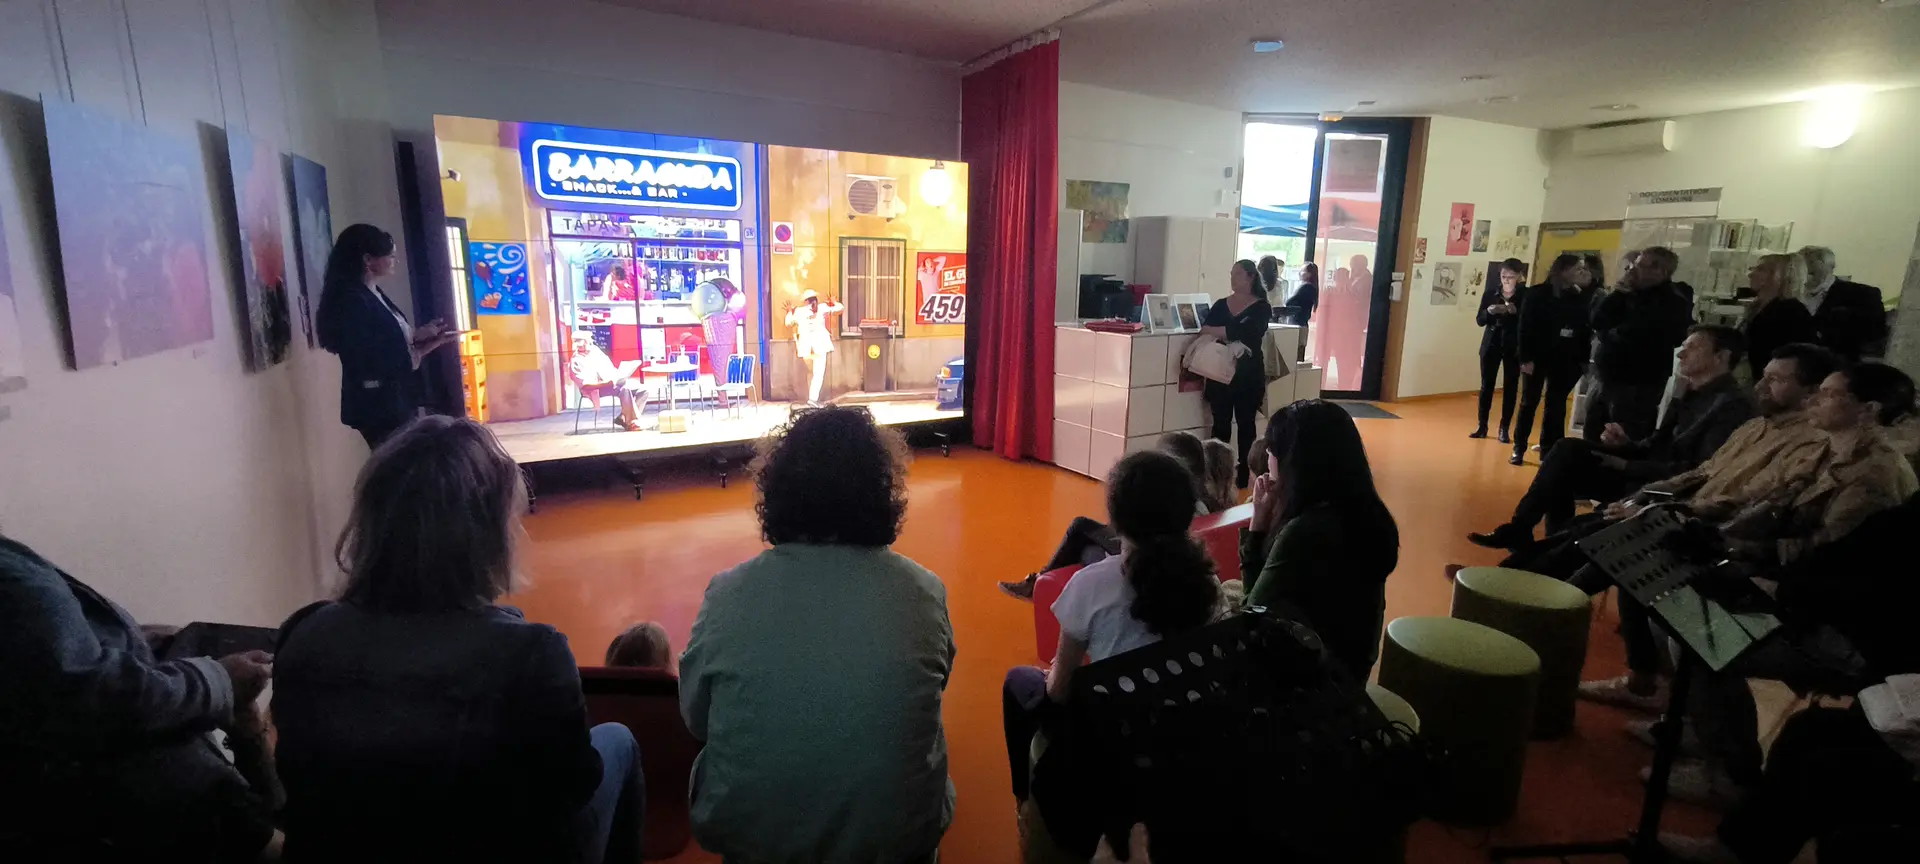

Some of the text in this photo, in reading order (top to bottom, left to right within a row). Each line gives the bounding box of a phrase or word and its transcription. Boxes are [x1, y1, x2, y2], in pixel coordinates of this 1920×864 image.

[647, 187, 679, 199] BAR
[563, 218, 621, 232] TAPAS
[920, 295, 965, 320] 459
